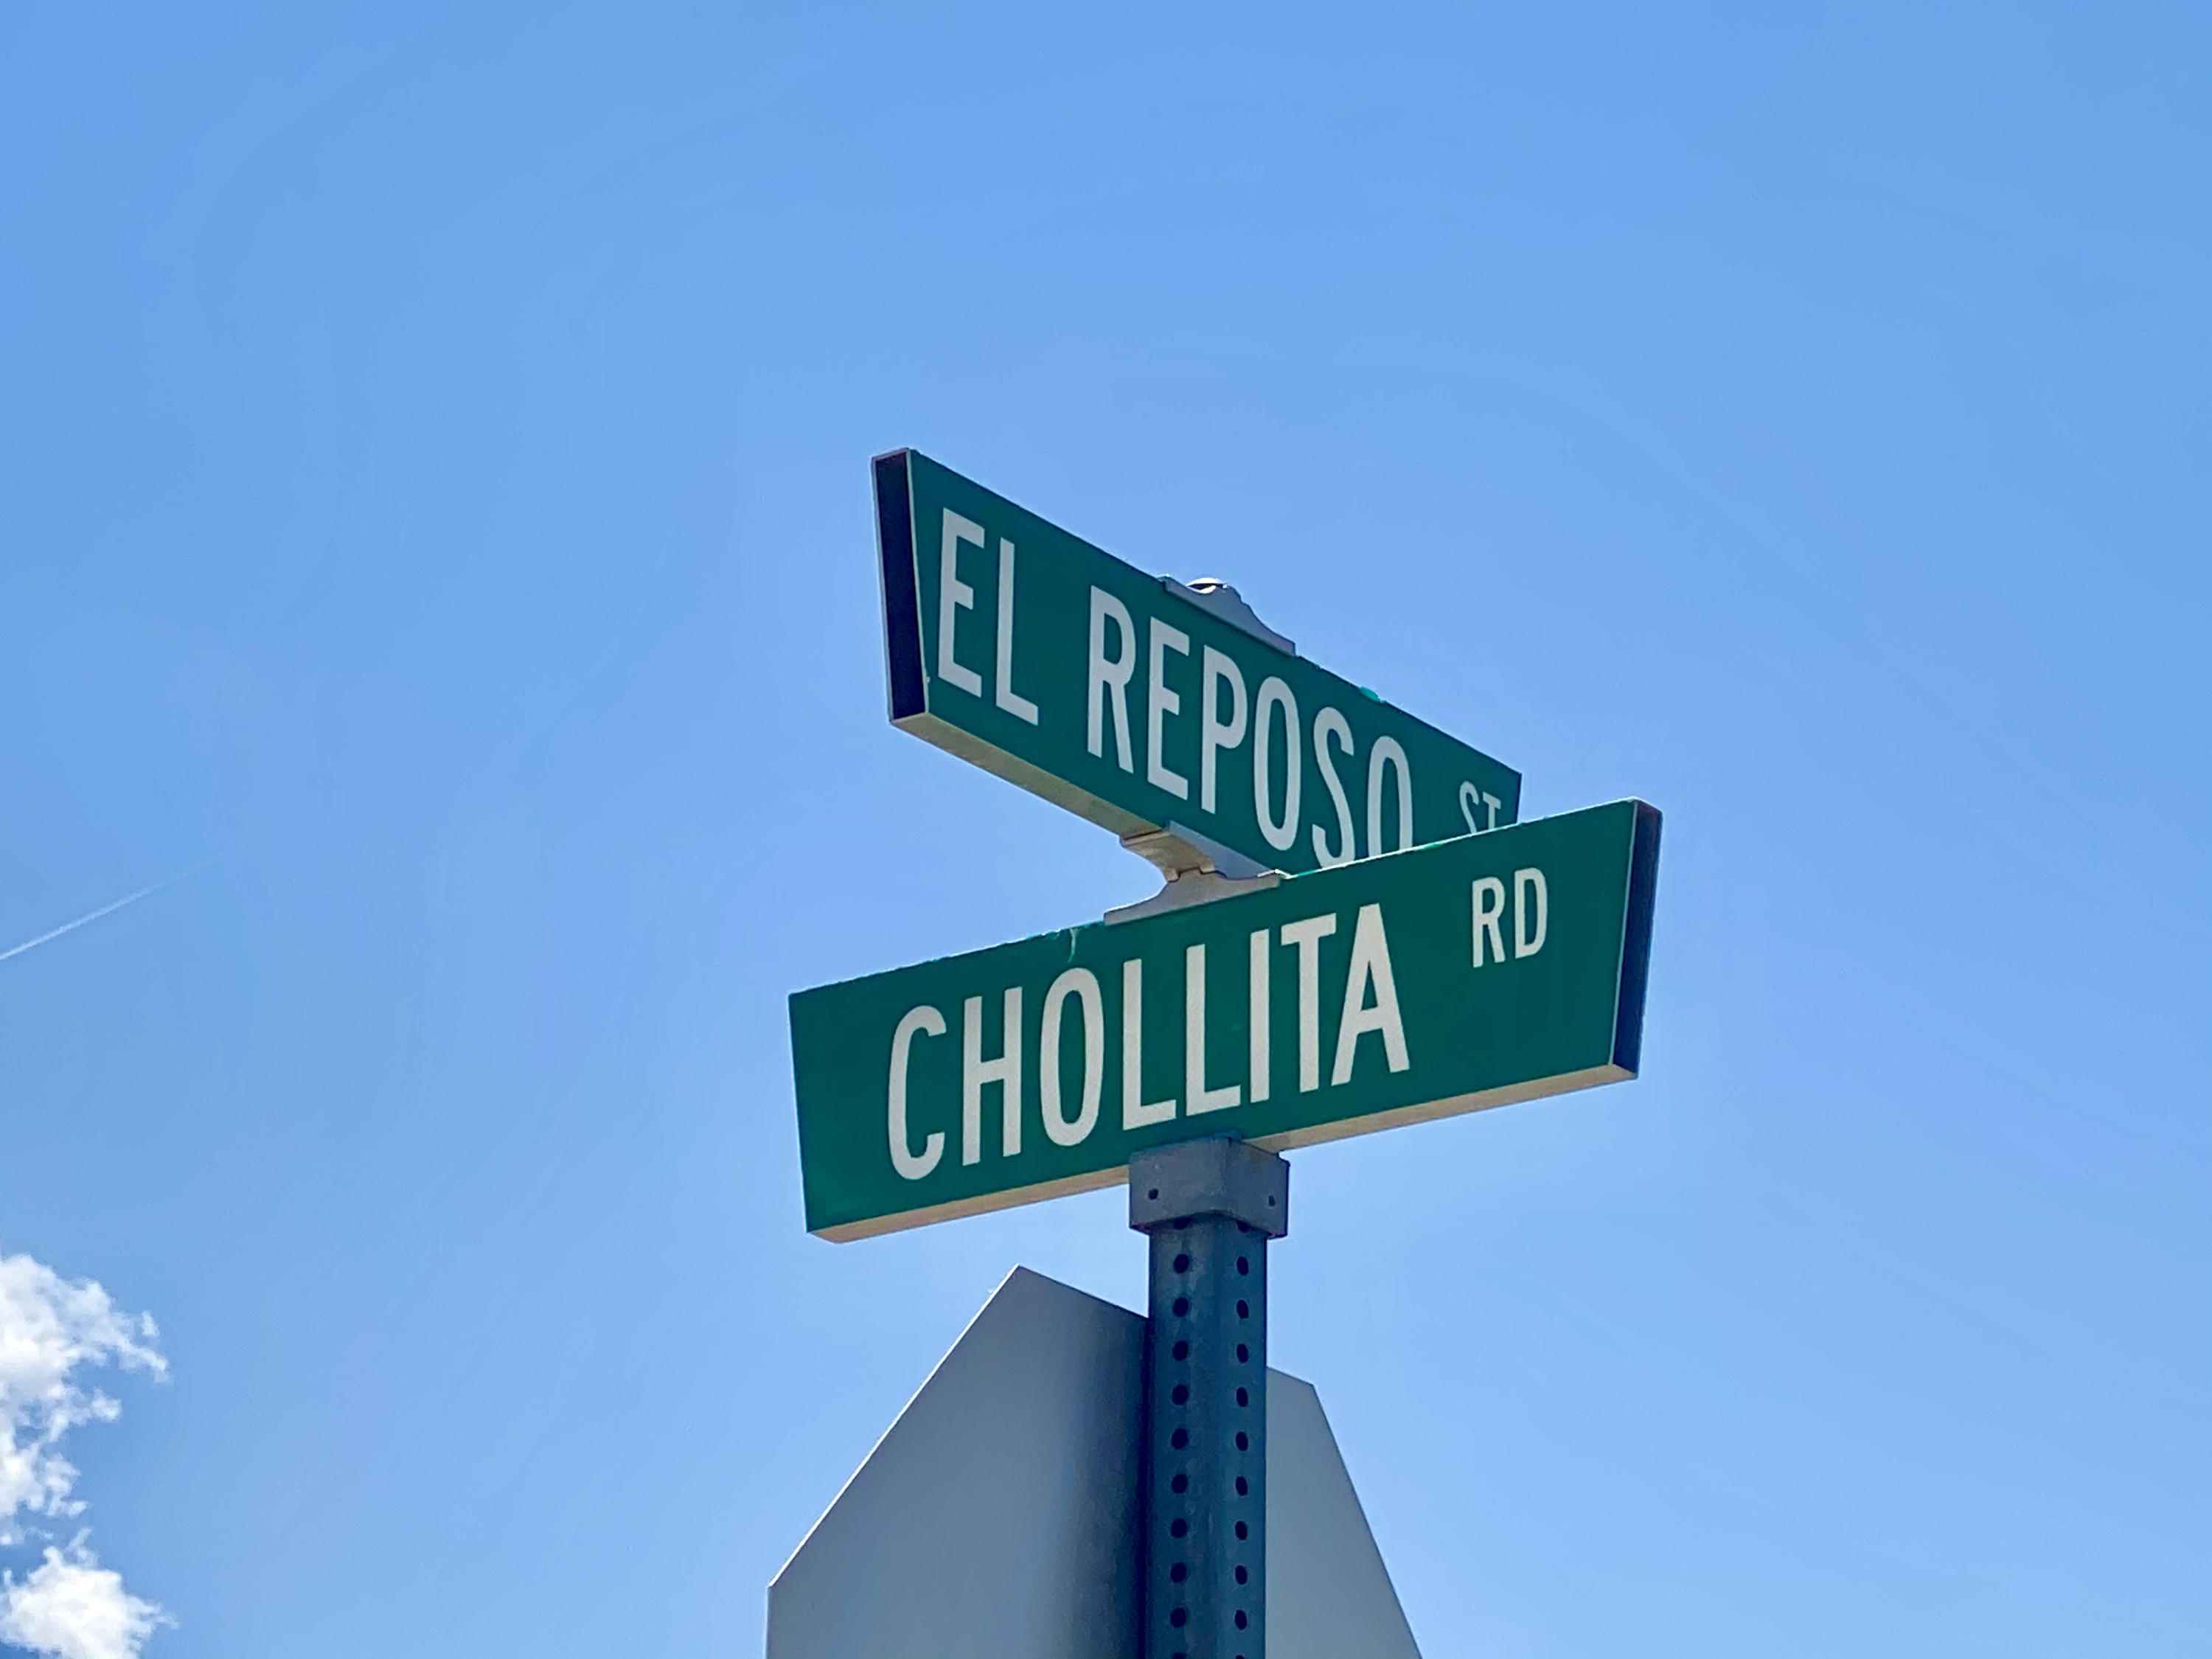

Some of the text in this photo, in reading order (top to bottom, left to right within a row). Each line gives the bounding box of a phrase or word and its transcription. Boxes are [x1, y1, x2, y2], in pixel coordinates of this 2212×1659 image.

[938, 507, 1040, 726] EL
[1086, 585, 1413, 869] REPOSO
[888, 867, 1548, 1180] CHOLLITA RD
